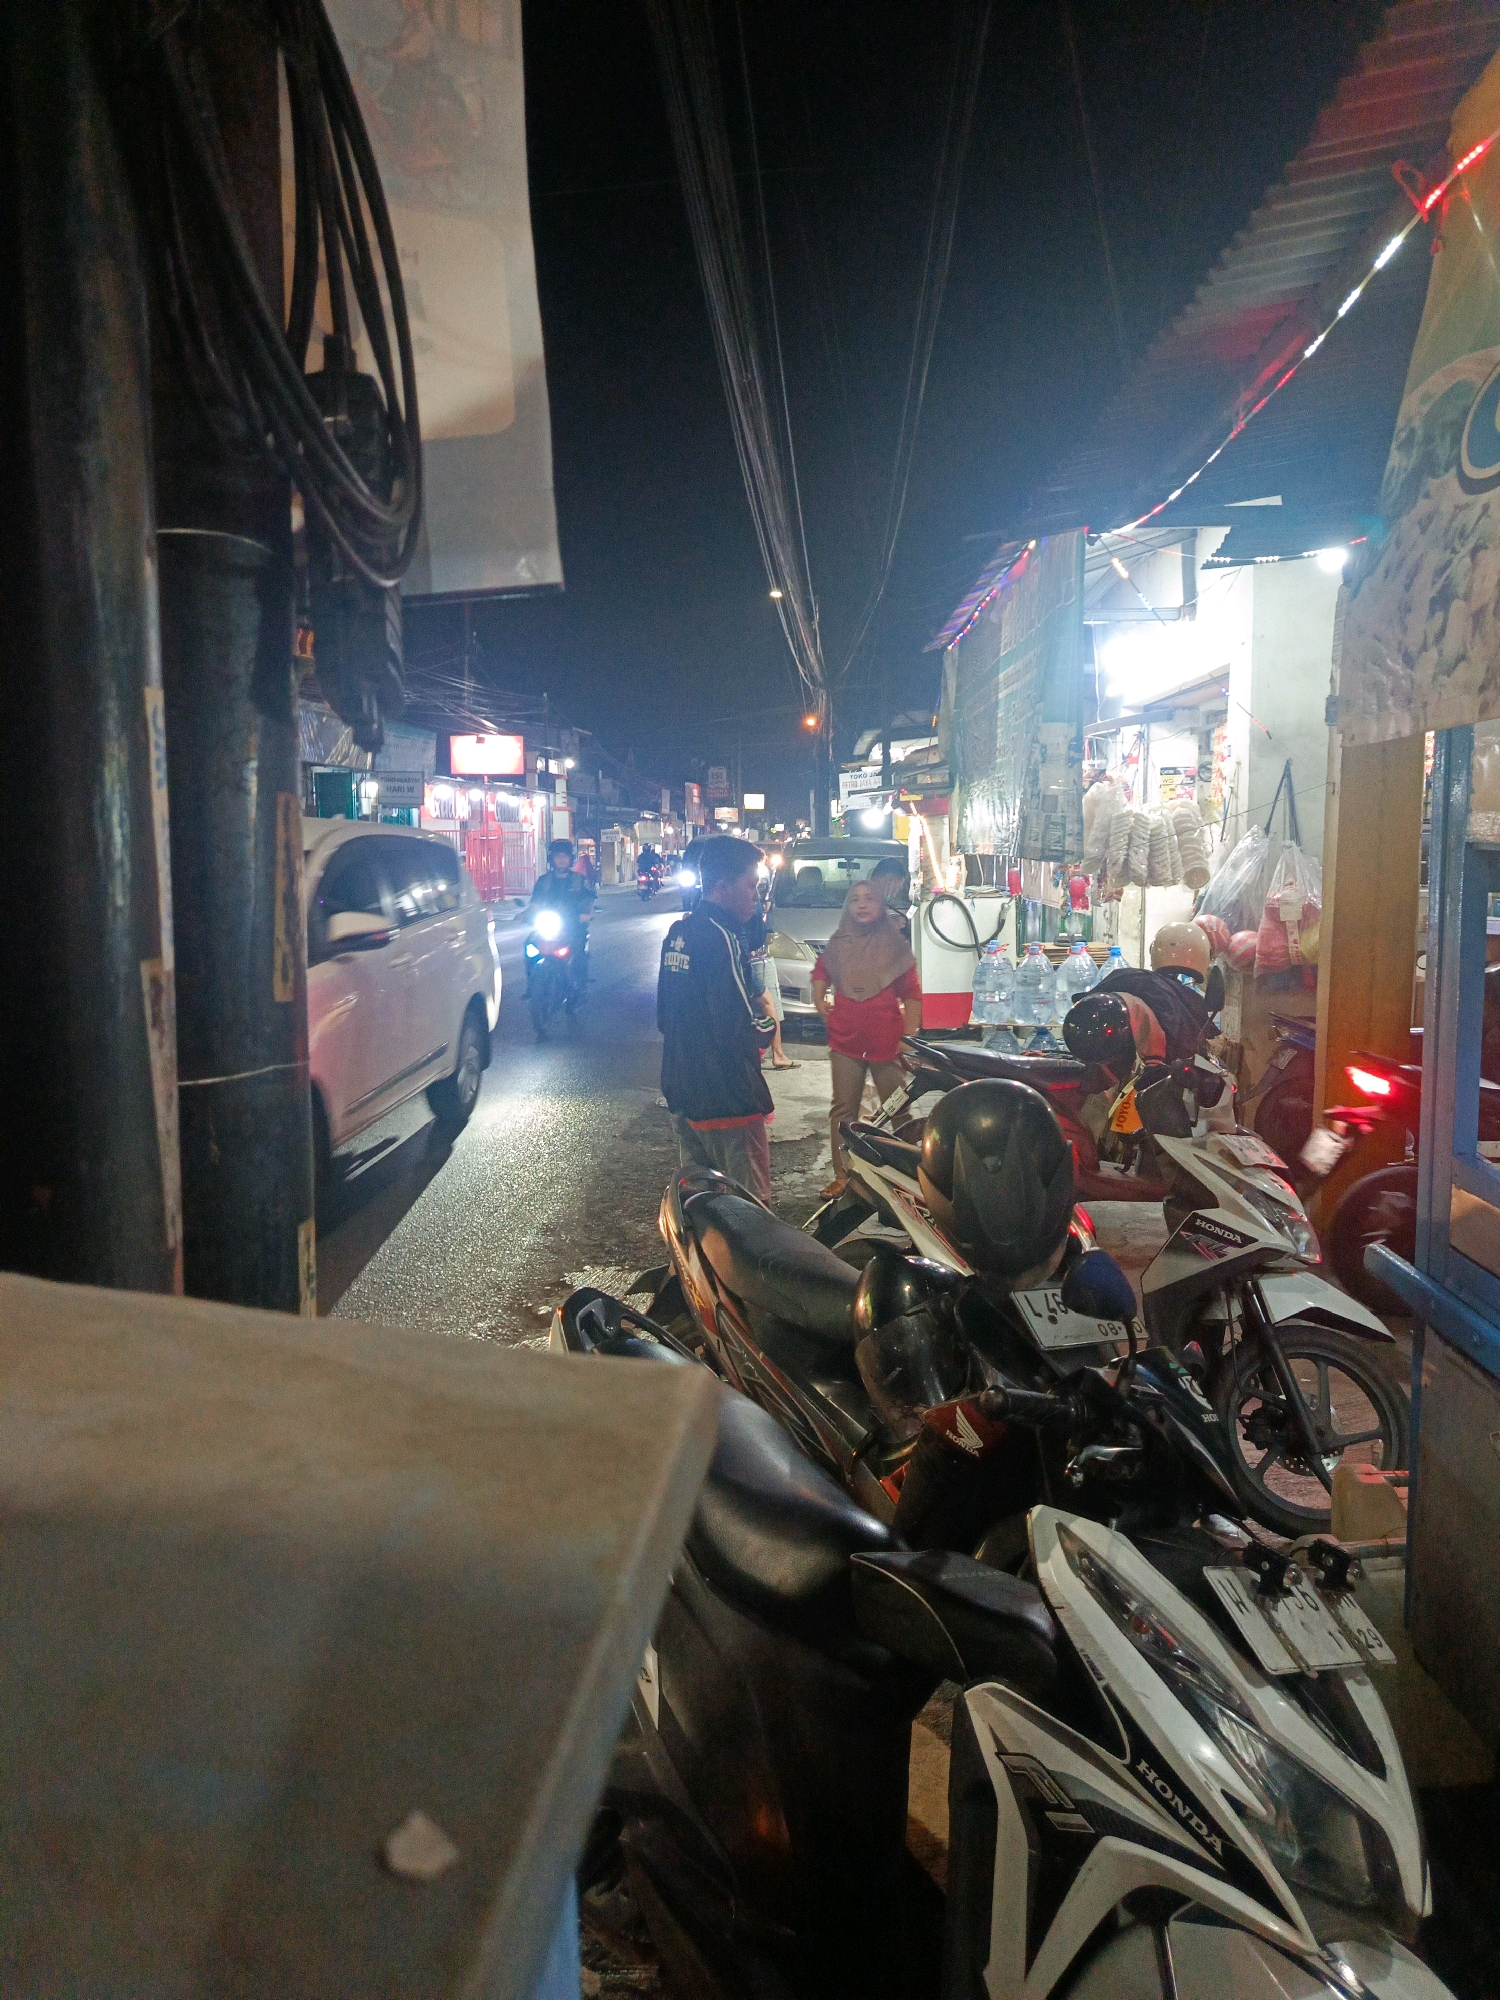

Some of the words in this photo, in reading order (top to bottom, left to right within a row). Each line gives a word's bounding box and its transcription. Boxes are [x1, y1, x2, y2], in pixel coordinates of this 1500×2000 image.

[1195, 1219, 1243, 1244] HONDA
[945, 1429, 981, 1458] HONDA
[1136, 1758, 1225, 1854] HONDA
